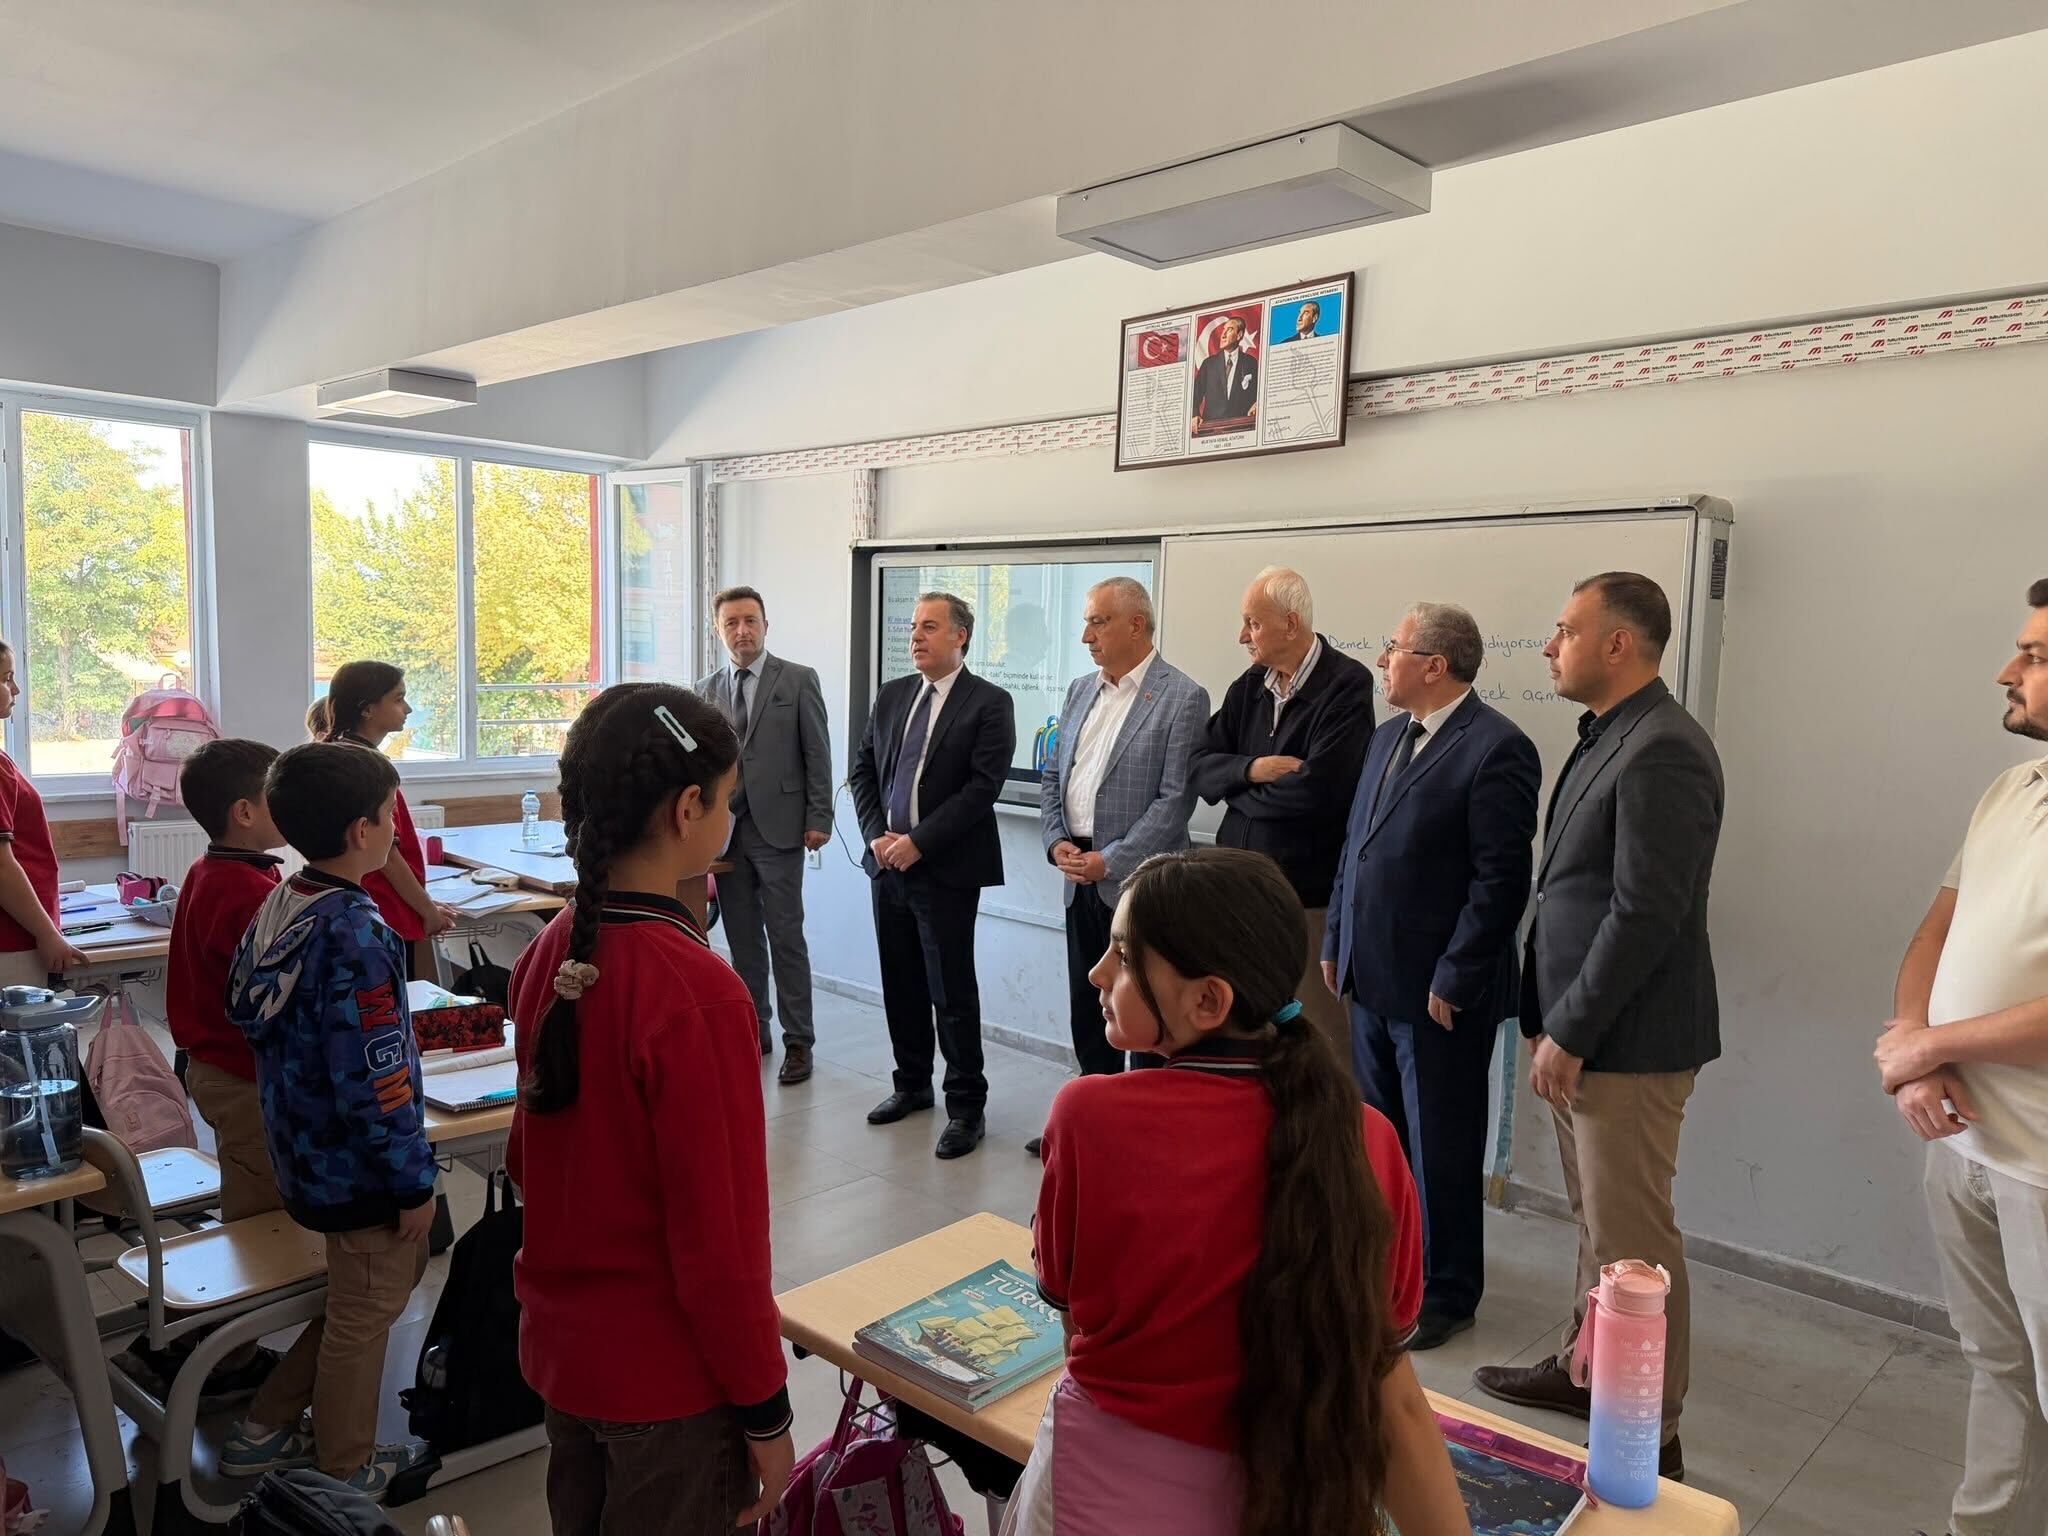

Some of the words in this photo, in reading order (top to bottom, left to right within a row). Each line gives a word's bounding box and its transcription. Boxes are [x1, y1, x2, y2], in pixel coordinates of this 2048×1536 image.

[1328, 634, 1372, 649] Demek
[1482, 634, 1552, 658] idiyorsun
[985, 1274, 1060, 1322] TÜRKÇ
